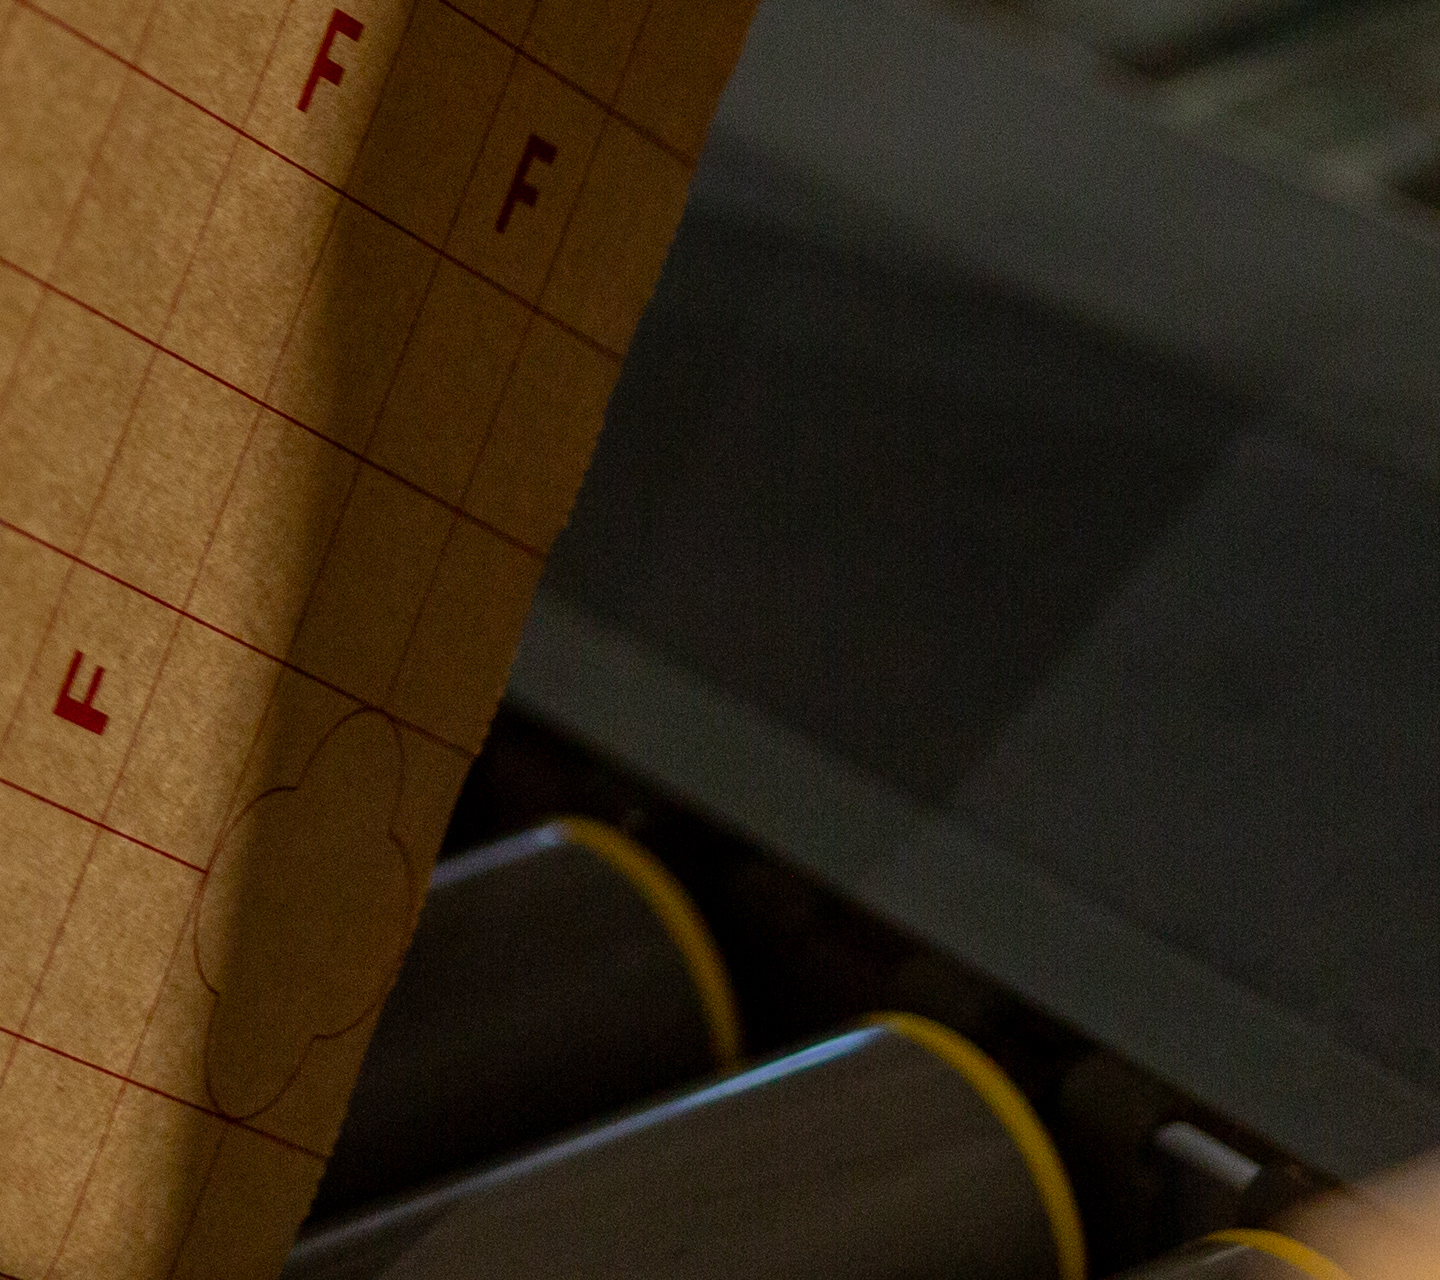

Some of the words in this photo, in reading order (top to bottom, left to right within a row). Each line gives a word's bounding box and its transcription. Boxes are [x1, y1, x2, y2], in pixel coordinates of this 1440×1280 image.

[296, 9, 363, 111] F
[496, 135, 556, 233] F
[54, 651, 109, 736] F
